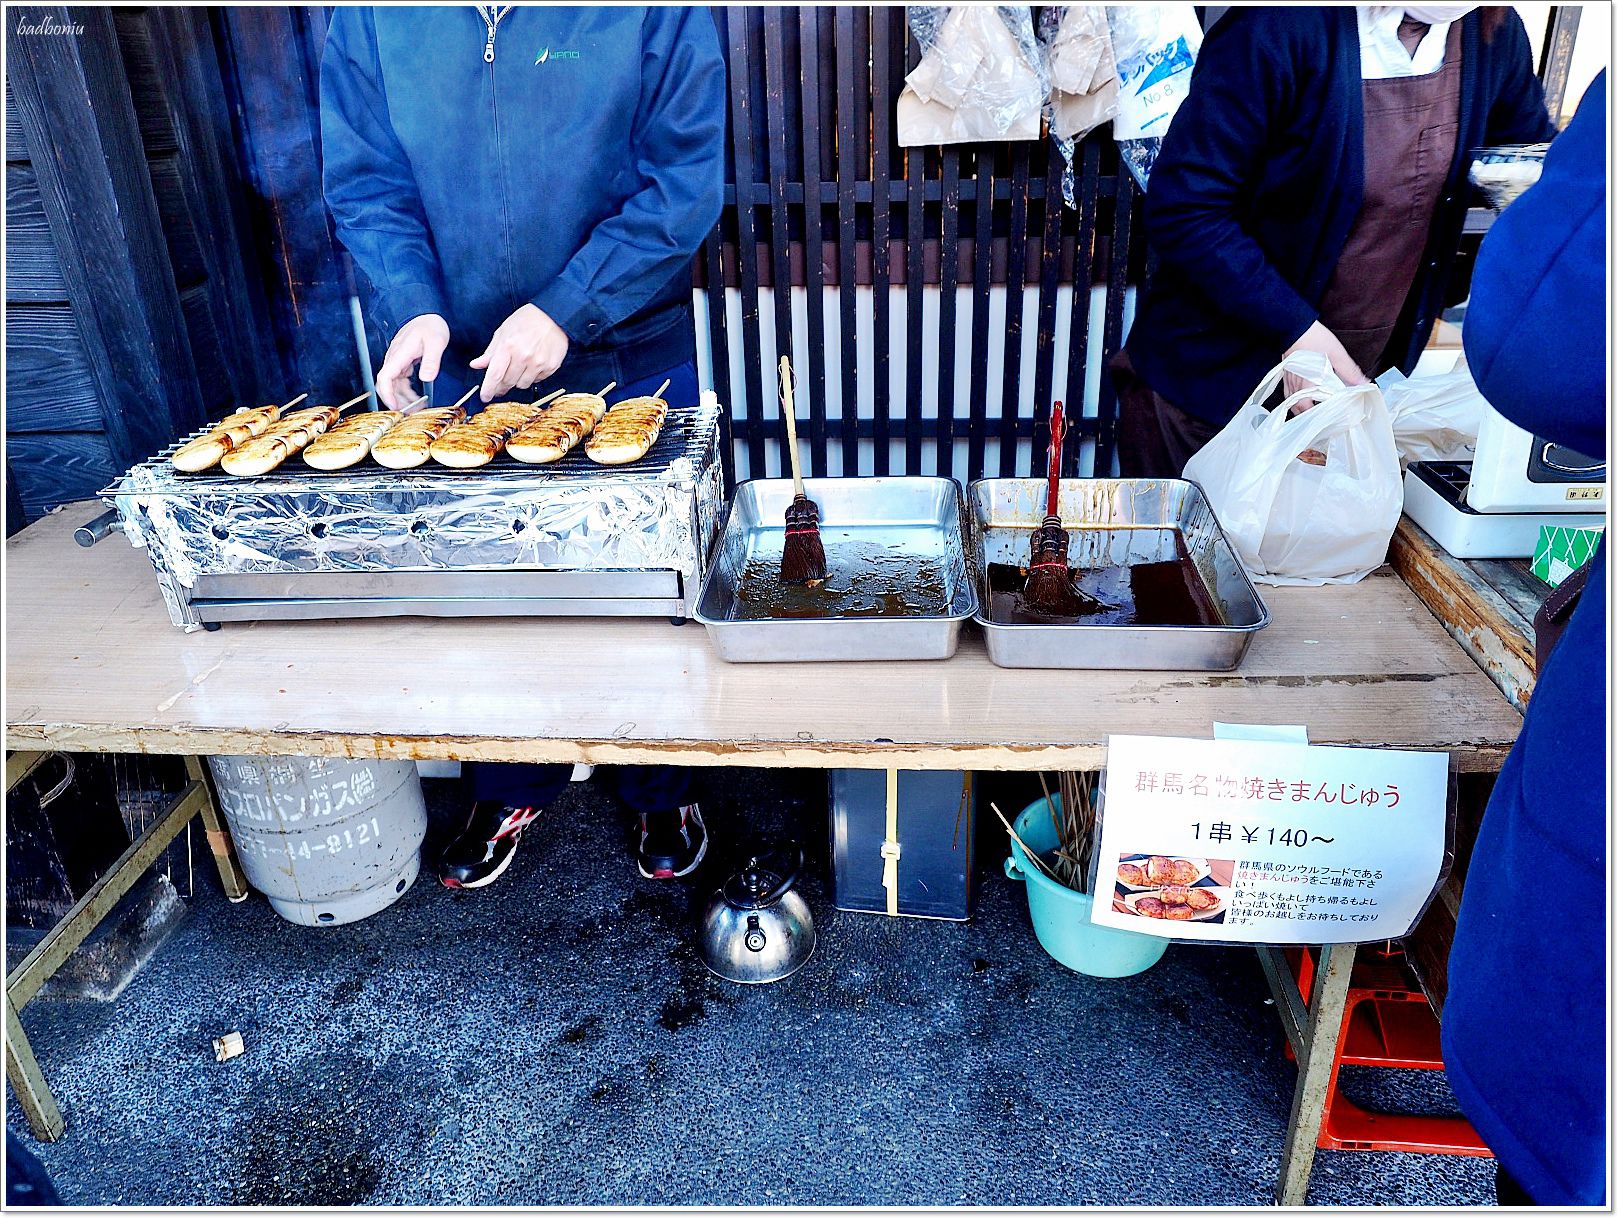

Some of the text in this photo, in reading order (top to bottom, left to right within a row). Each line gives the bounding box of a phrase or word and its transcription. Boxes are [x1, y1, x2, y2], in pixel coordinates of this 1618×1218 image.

[1135, 771, 1400, 808] 群馬名物焼きまんじゅう
[1238, 860, 1383, 880] 群馬県のソウルフードである
[1234, 889, 1378, 906] 食べ歩くもよし持ち帰るもよし
